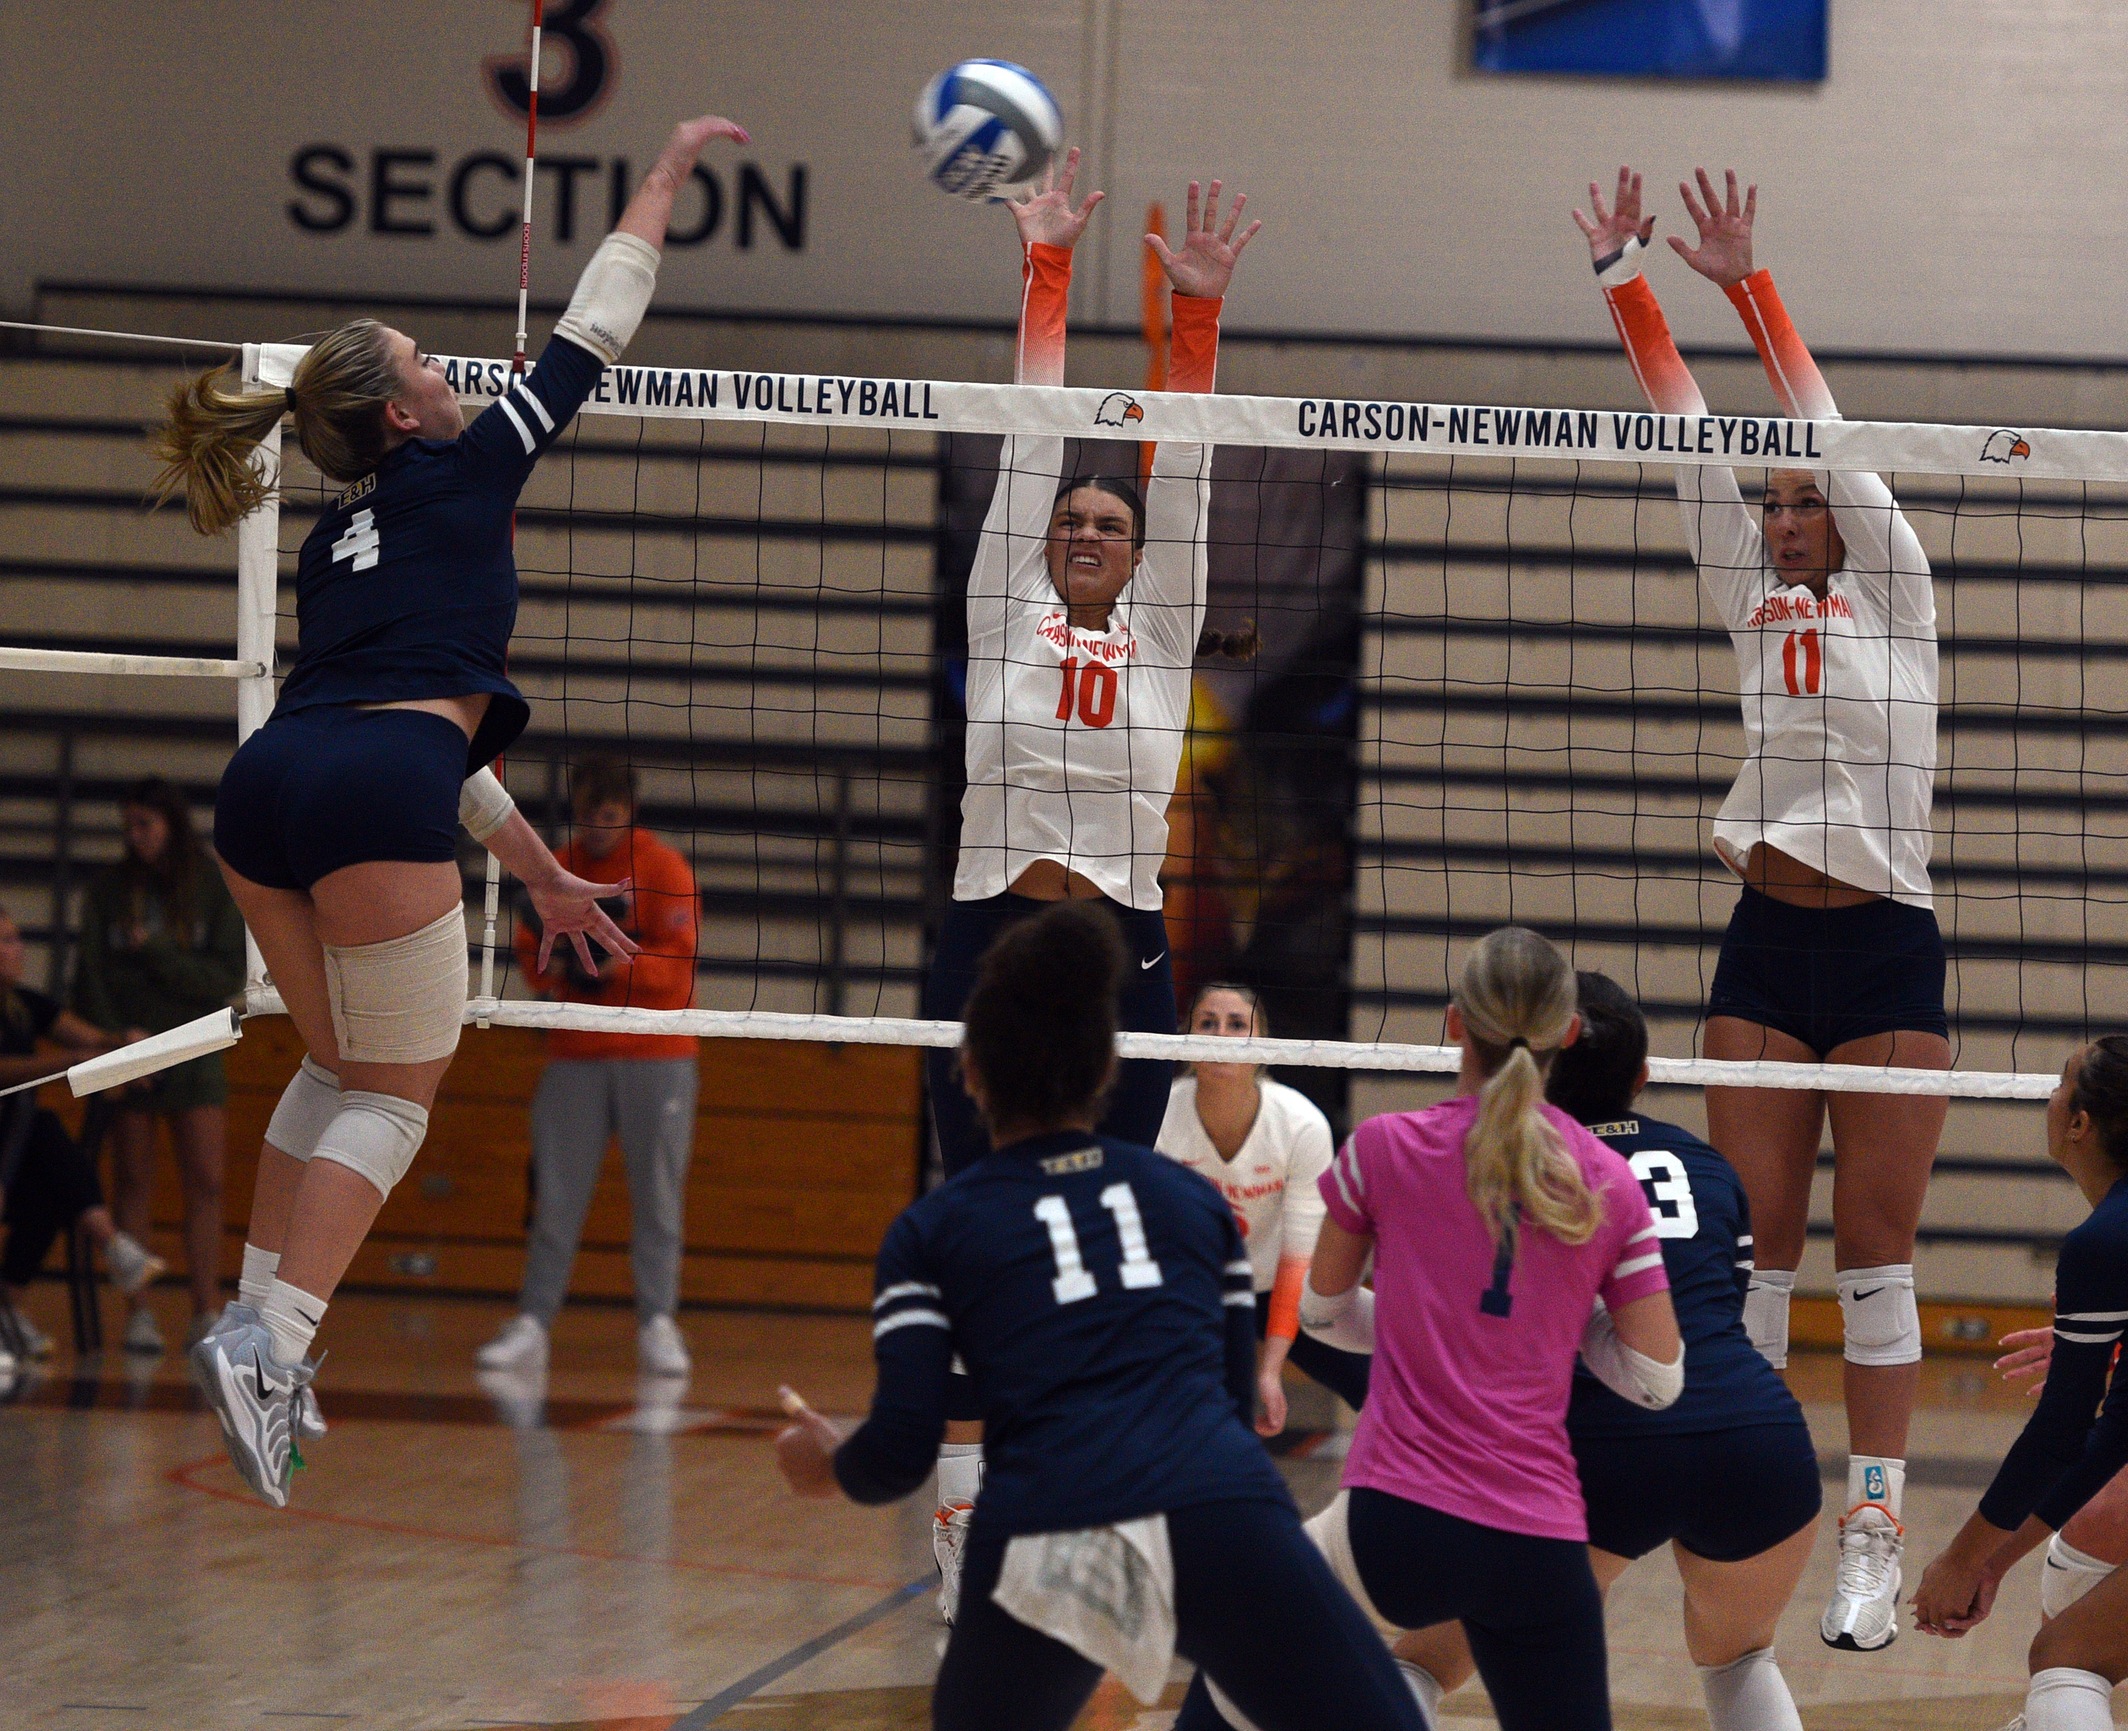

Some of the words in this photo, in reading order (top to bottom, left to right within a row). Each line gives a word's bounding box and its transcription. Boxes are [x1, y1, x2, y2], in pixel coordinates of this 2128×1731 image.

[483, 0, 619, 129] 3
[287, 143, 810, 251] SECTION
[734, 374, 939, 420] VOLLEYBALL
[1299, 400, 1598, 449] CARSON-NEWMAN
[1613, 414, 1822, 459] VOLLEYBALL
[337, 472, 377, 511] E&H
[331, 507, 380, 573] 4
[1055, 656, 1118, 729] 10
[1782, 628, 1822, 696] 11
[1591, 1120, 1640, 1137] E&H
[1033, 1181, 1164, 1305] 11
